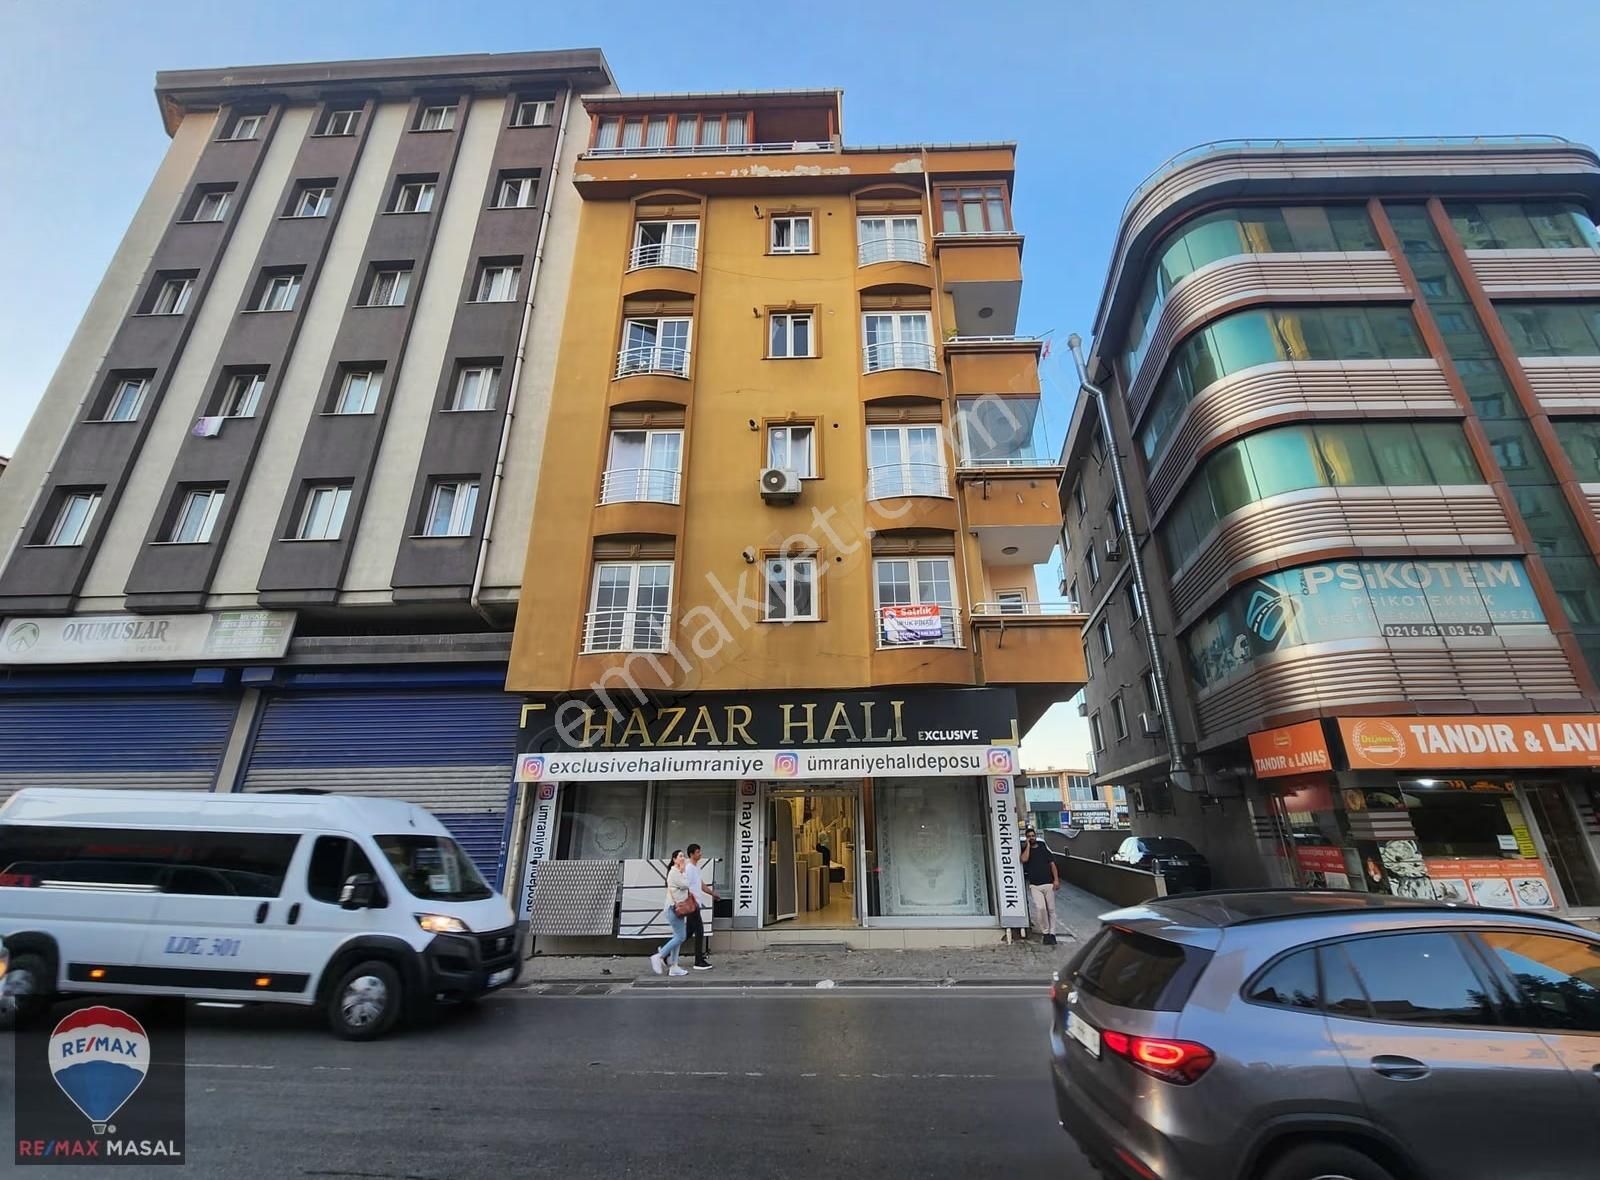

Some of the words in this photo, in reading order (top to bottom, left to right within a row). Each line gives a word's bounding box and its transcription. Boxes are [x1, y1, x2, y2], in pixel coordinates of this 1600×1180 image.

[1385, 626, 1419, 637] 0216
[1422, 625, 1446, 636] 481
[1448, 626, 1465, 636] 03
[1468, 625, 1485, 636] 43
[578, 705, 758, 748] HAZAR
[778, 700, 908, 745] HALI
[918, 729, 979, 742] EXCLUSIVE
[1409, 723, 1516, 753] TANDIR
[1524, 730, 1544, 753] &
[1542, 723, 1600, 752] LAV
[549, 756, 764, 775] exclusivehaliumraniye
[1255, 756, 1287, 772] TANDIR
[739, 801, 755, 910] hayalhalicilik
[996, 799, 1018, 909] mekikhalicilik
